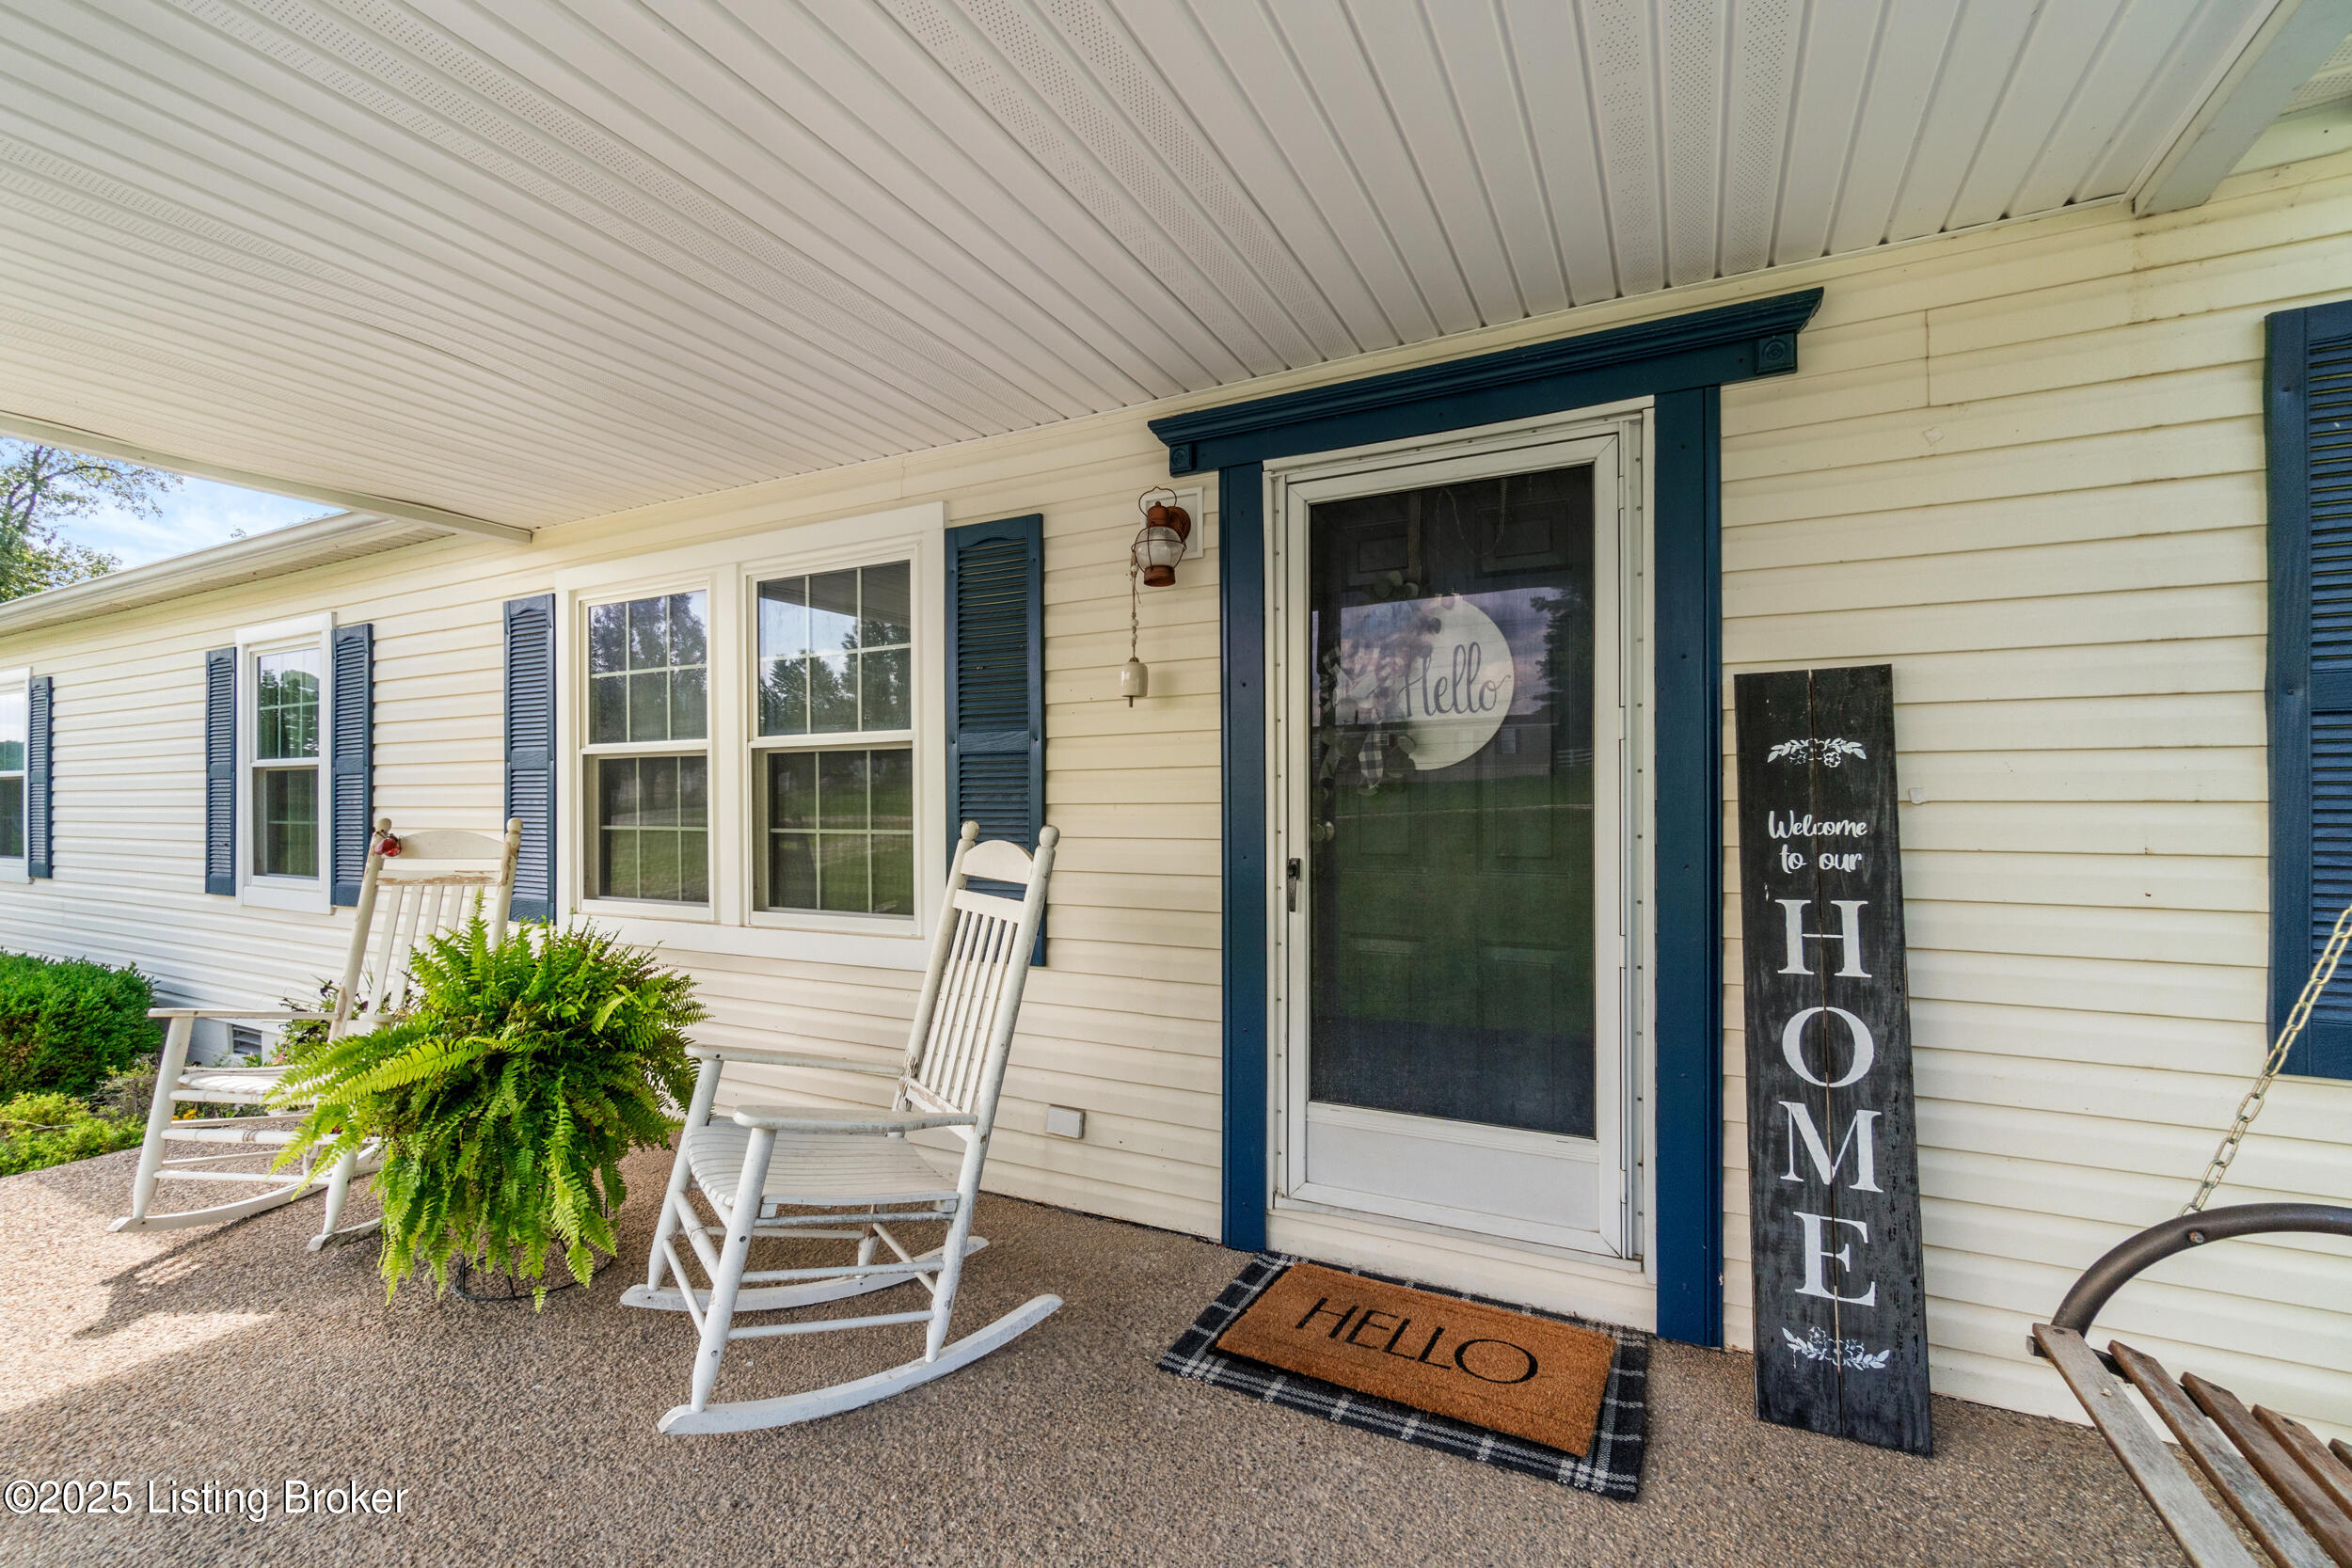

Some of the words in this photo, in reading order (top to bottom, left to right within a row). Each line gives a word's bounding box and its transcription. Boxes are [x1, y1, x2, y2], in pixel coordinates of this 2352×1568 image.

[1398, 641, 1512, 718] Hello
[1768, 810, 1868, 839] Welcome
[1779, 844, 1807, 874] to
[1819, 852, 1863, 873] our
[1774, 898, 1884, 1307] HOME
[1295, 1297, 1539, 1385] HELLO
